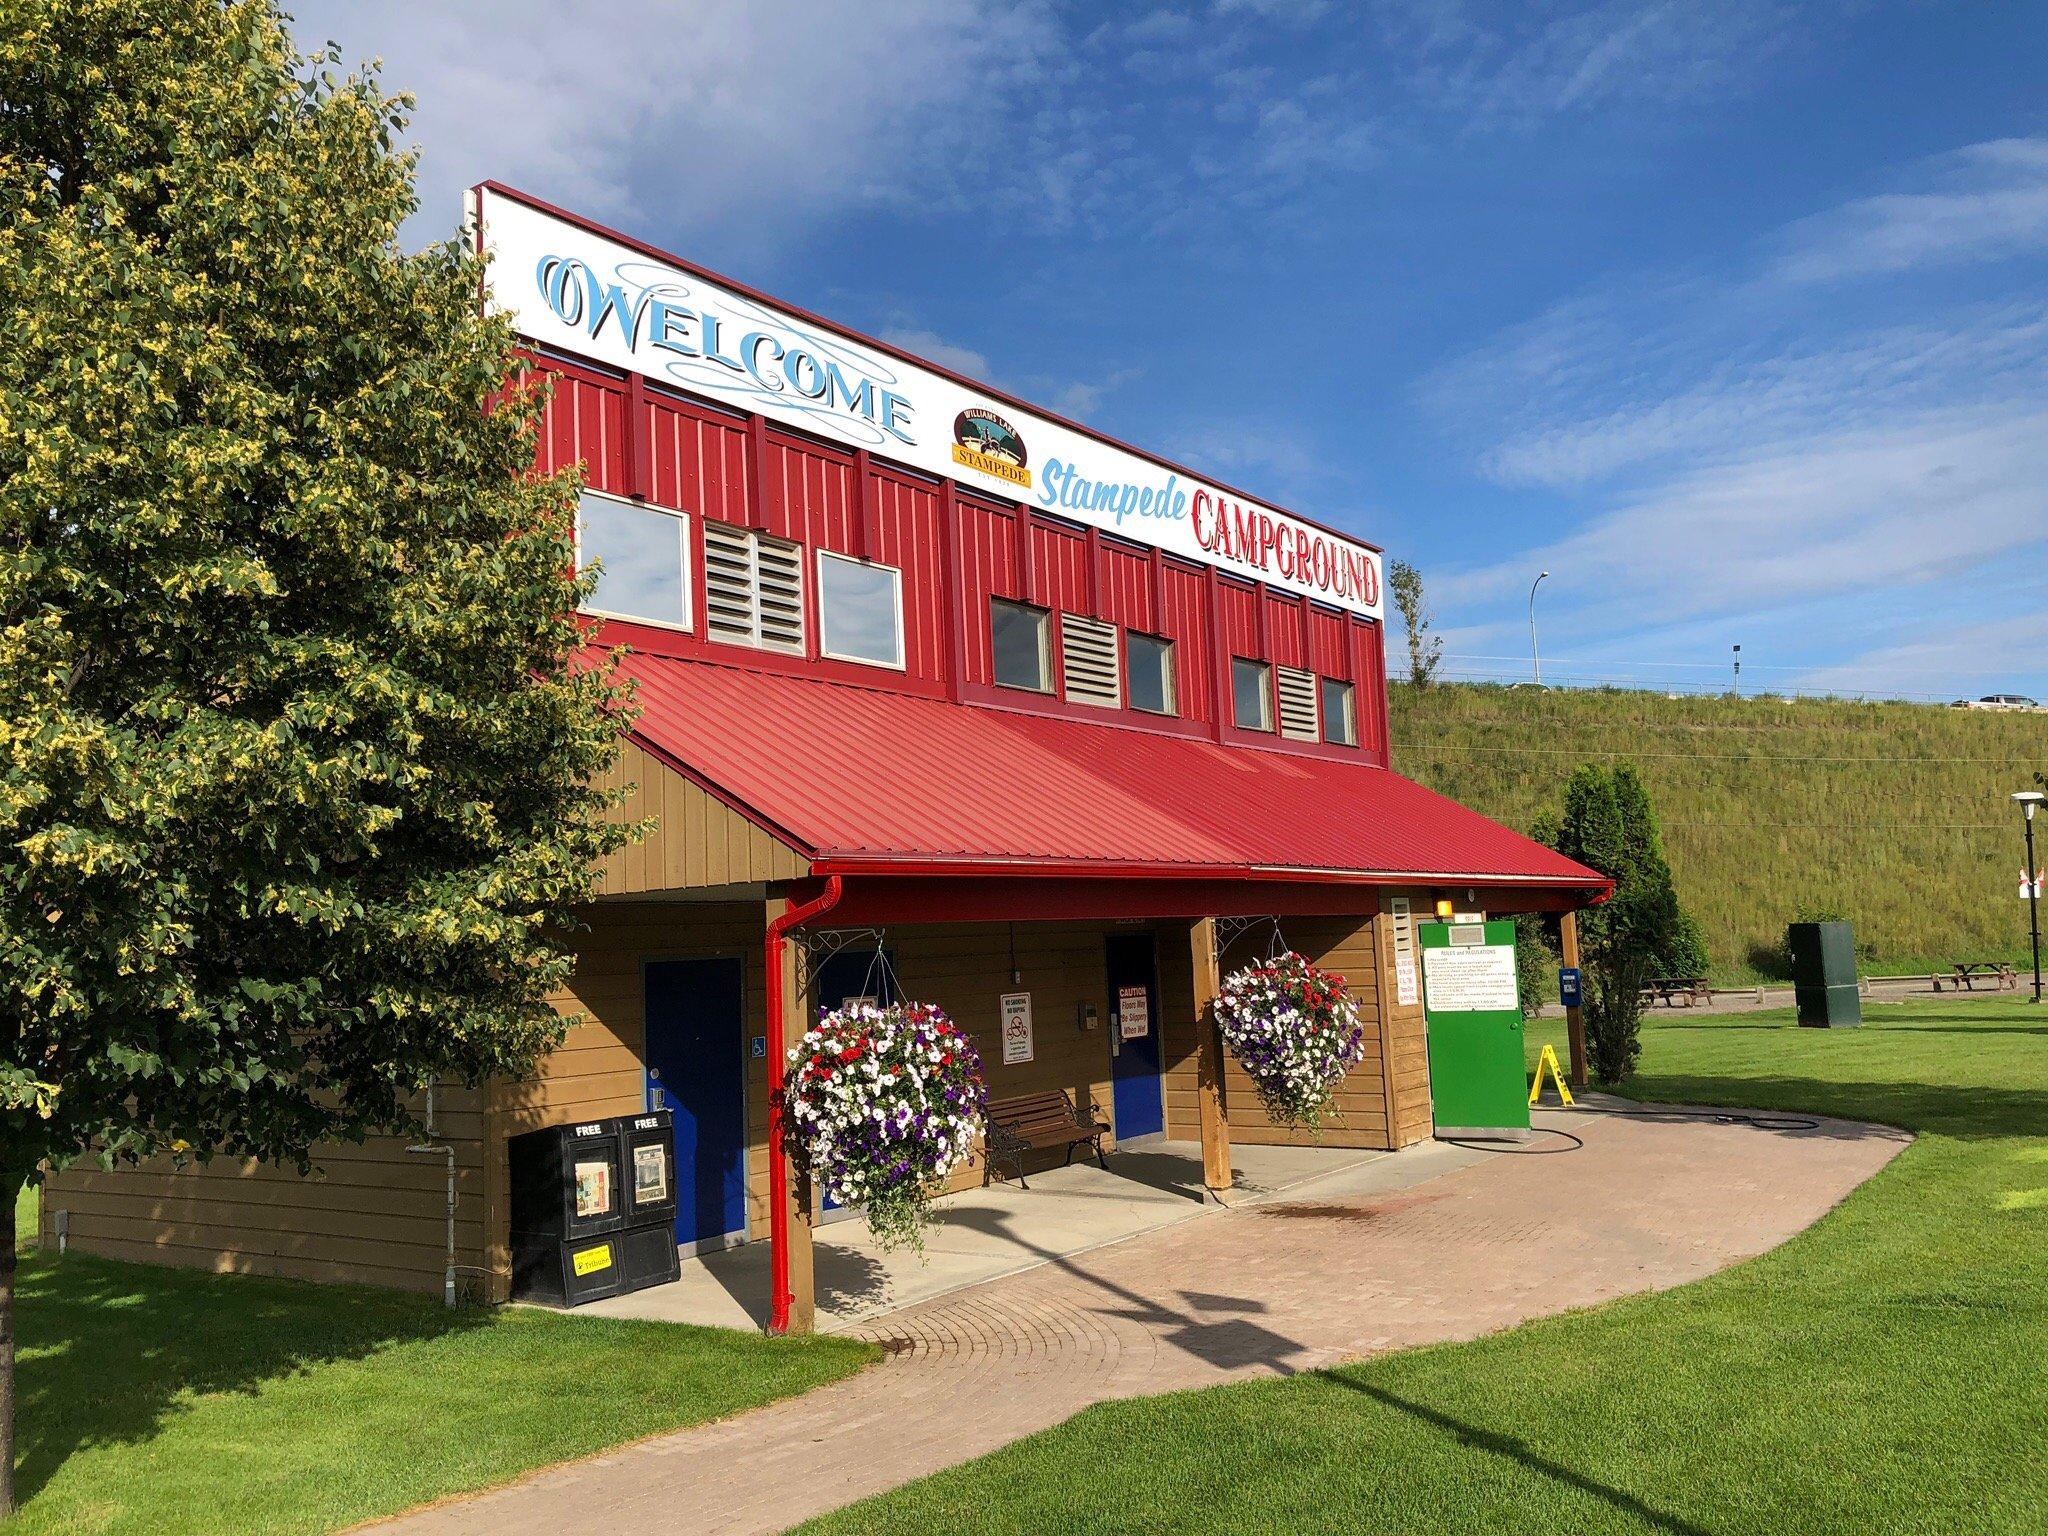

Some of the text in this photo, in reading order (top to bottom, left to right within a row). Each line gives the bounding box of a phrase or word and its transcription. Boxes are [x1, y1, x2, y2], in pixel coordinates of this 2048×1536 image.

[536, 254, 918, 446] WELCOME
[964, 409, 1017, 438] WILLIAMS LAKE
[959, 449, 1026, 483] STAMPEDE
[1037, 457, 1379, 606] Stampede CAMPGROUND
[1120, 987, 1146, 997] CAUTION
[1122, 1001, 1136, 1010] Floors
[1121, 1013, 1146, 1023] Be Slippery
[1123, 1026, 1137, 1034] When
[634, 1117, 659, 1130] FREE
[575, 1124, 602, 1137] FREE
